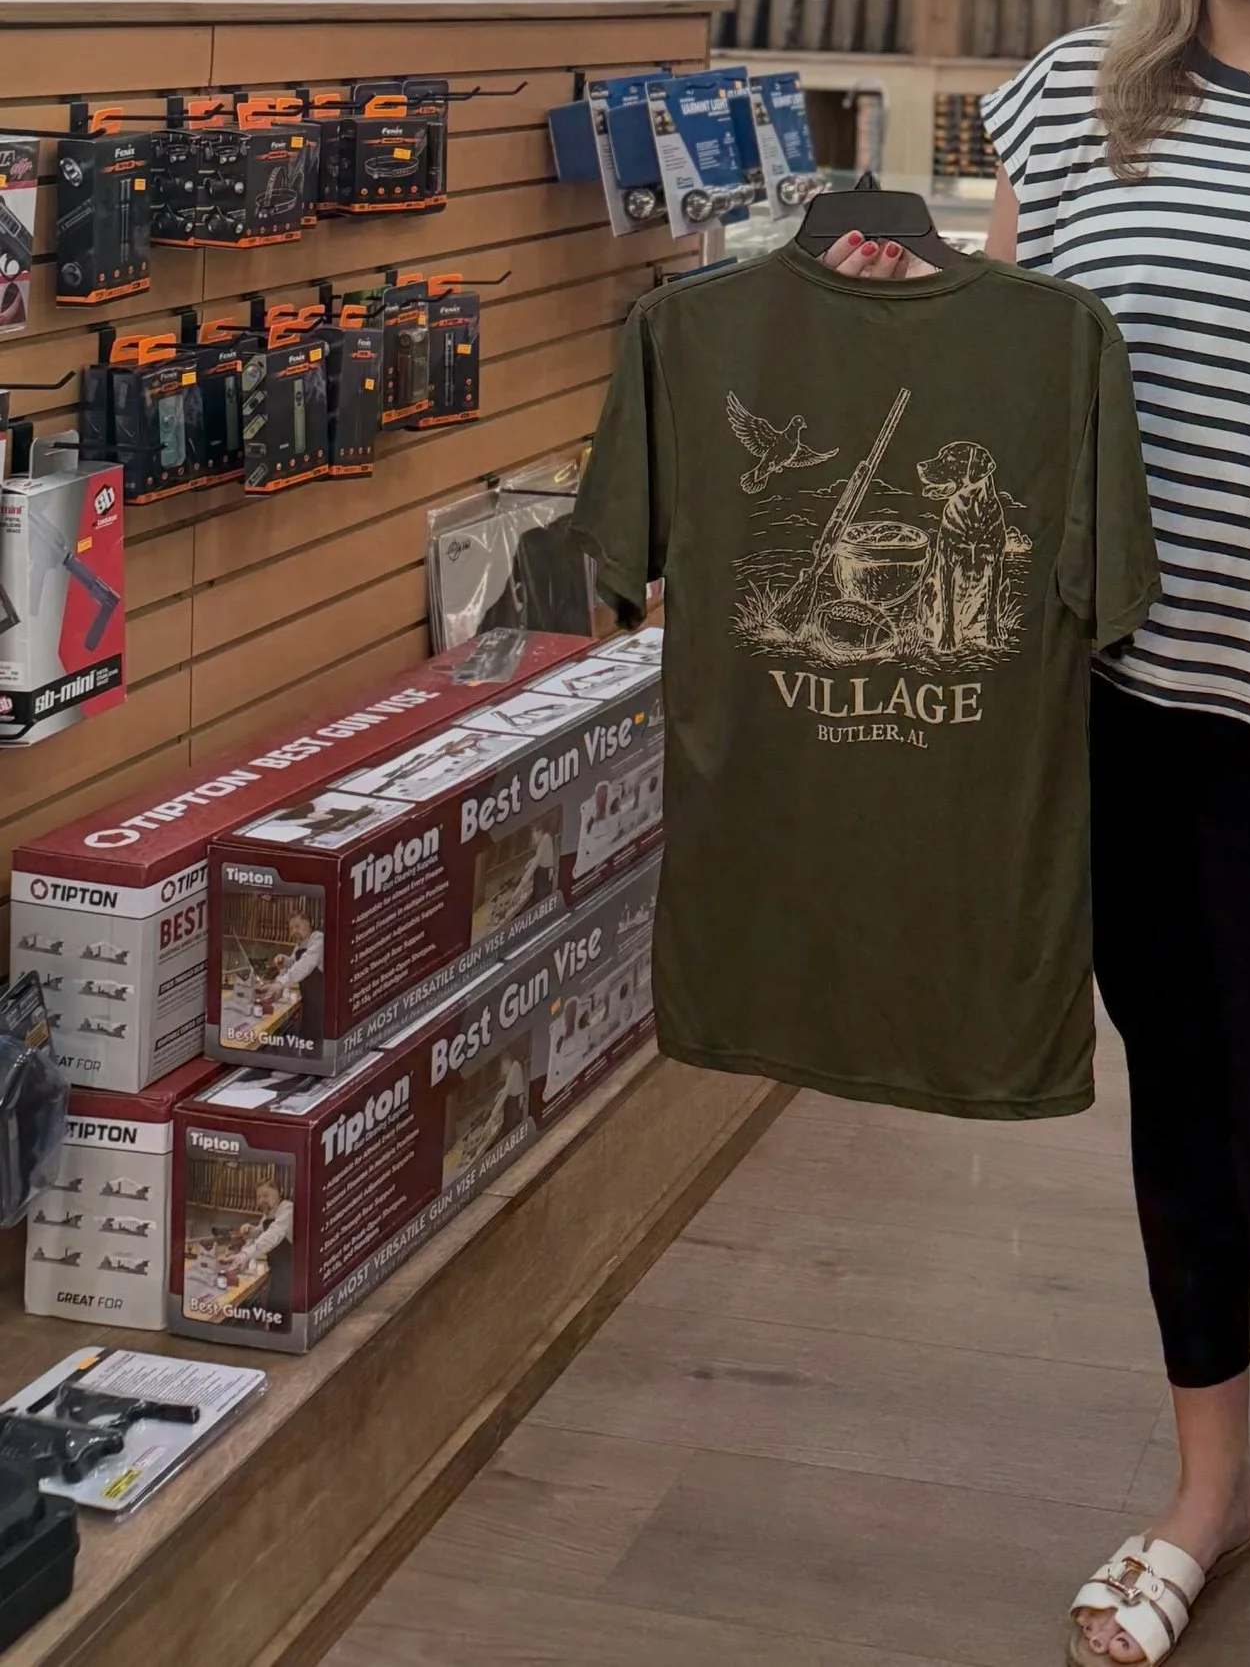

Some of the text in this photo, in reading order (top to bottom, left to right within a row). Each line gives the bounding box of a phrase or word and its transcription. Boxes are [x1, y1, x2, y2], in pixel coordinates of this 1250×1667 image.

[34, 669, 97, 715] sb-mini
[768, 670, 984, 725] VILLAGE
[120, 687, 442, 831] TIPTON BEST GUN VISE
[817, 723, 928, 749] BUTLER, AL
[460, 717, 634, 845] Best Gun Vise
[226, 867, 274, 885] Tipton
[350, 826, 441, 901] Tipton
[50, 883, 119, 909] TIPTON
[159, 900, 207, 951] BEST
[343, 895, 559, 1053] THE MOST VERSATILE GUN VISE AVAILABLE!
[431, 1004, 493, 1088] Best
[499, 966, 550, 1030] Gun
[553, 926, 603, 985] Vise
[227, 1027, 315, 1051] Best Gun Vise
[76, 1058, 102, 1072] FOR
[68, 1121, 138, 1145] TIPTON
[190, 1132, 240, 1153] Tipton
[320, 1074, 411, 1167] Tipton
[313, 1121, 529, 1327] THE MOST VERSATILE GUN VISE AVAILABLE!
[57, 1291, 124, 1310] GREAT FOR
[190, 1297, 283, 1325] Best Gun Vise
